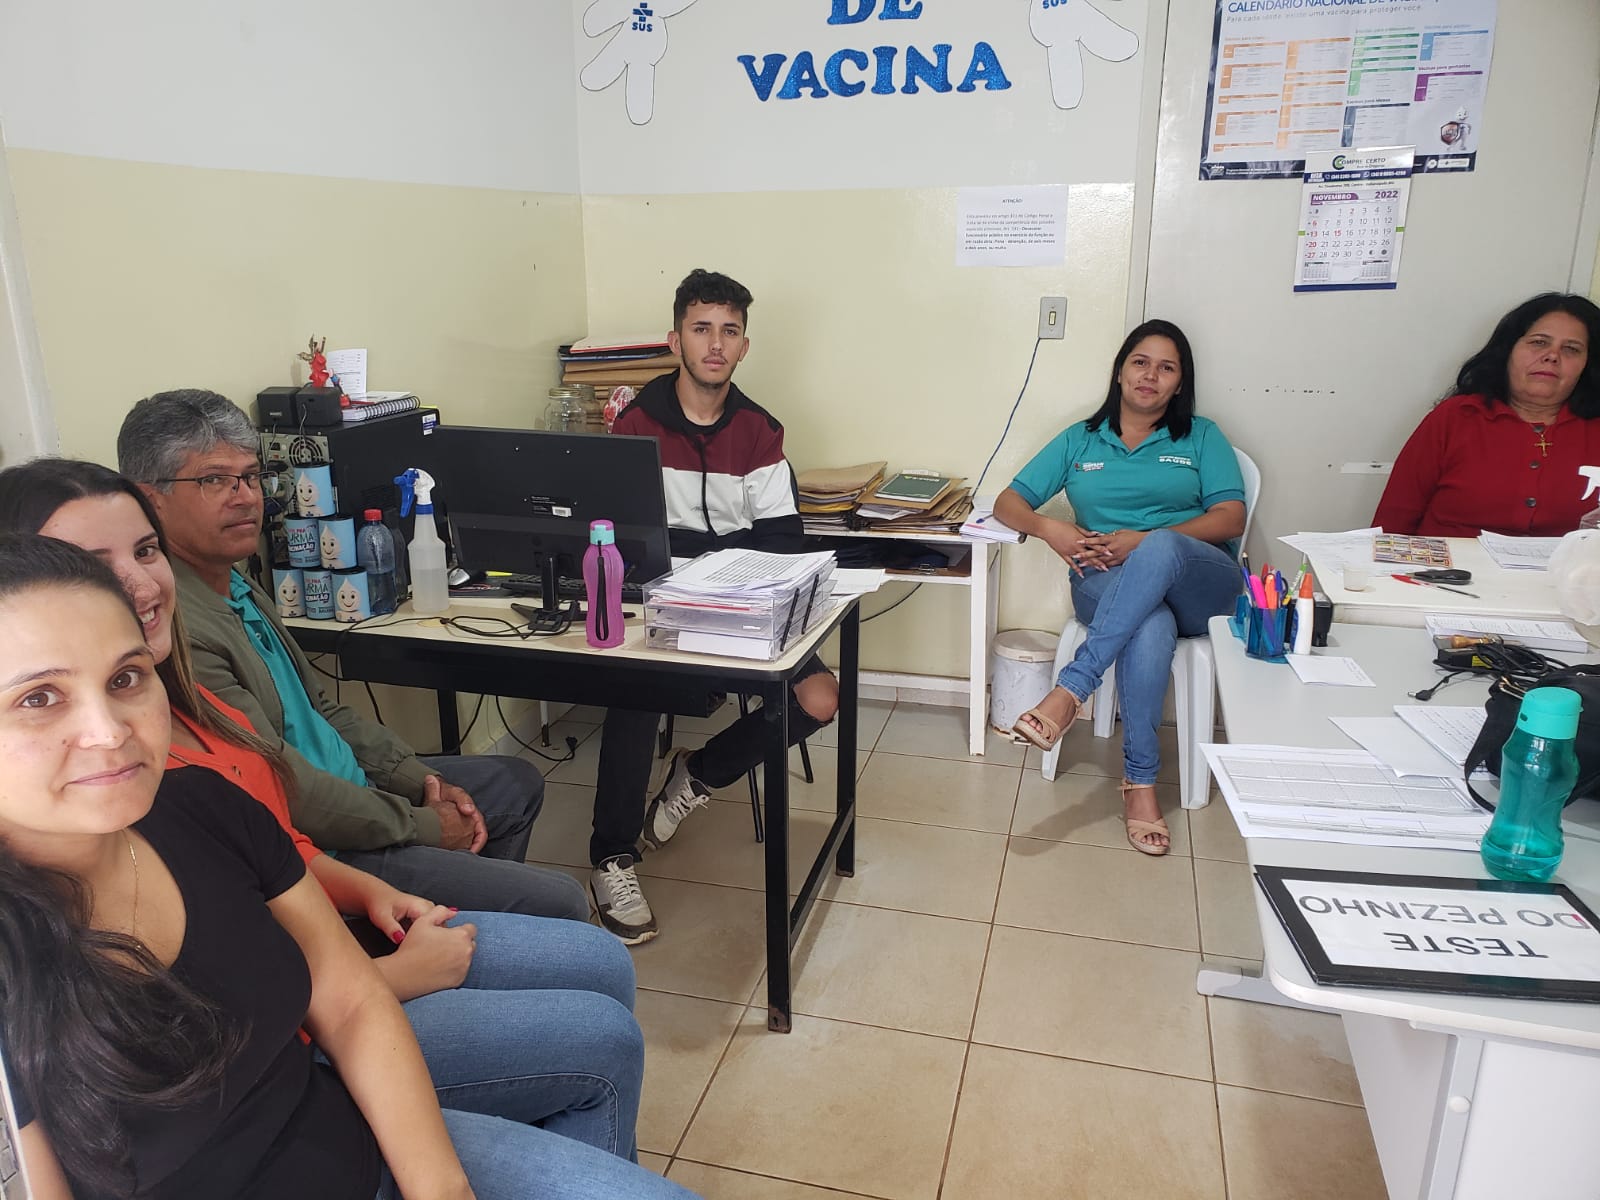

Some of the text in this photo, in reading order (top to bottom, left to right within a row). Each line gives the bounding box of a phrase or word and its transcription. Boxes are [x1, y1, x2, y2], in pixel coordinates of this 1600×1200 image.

[632, 22, 653, 32] SUS
[737, 42, 1011, 102] VACINA
[1375, 190, 1398, 199] 2022
[289, 532, 314, 544] URMA
[1299, 895, 1591, 930] DO PEZINHO
[1383, 932, 1549, 958] TESTE
